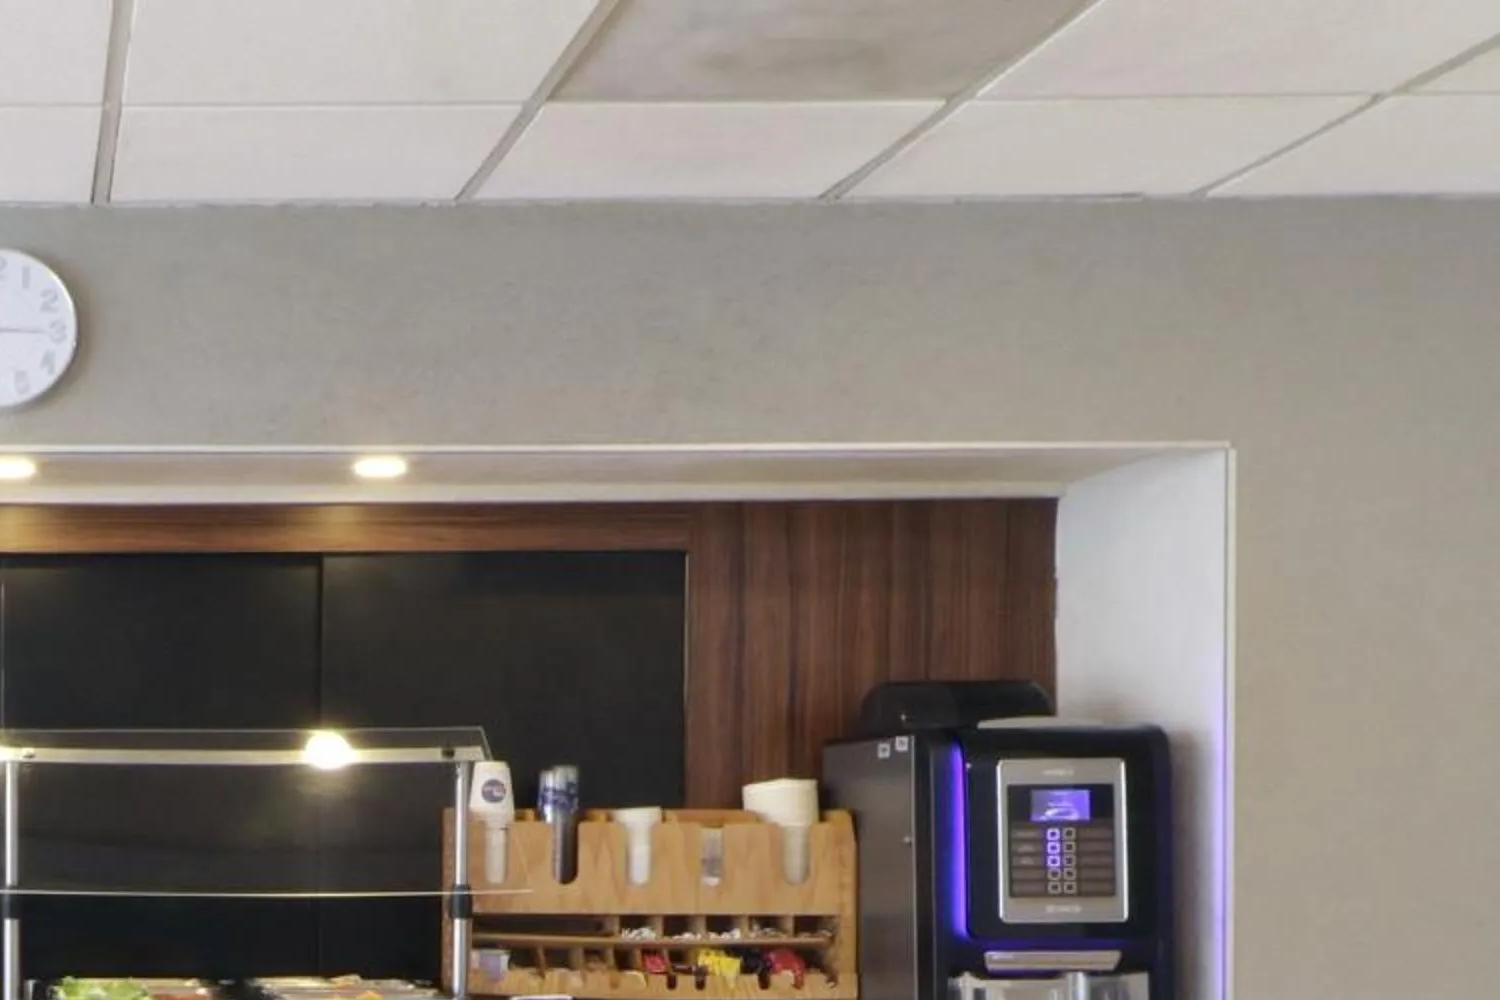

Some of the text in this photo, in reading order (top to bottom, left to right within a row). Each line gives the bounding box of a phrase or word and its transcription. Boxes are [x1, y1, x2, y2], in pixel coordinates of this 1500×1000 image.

[21, 265, 31, 290] 1
[39, 288, 59, 313] 2
[49, 319, 68, 344] 3
